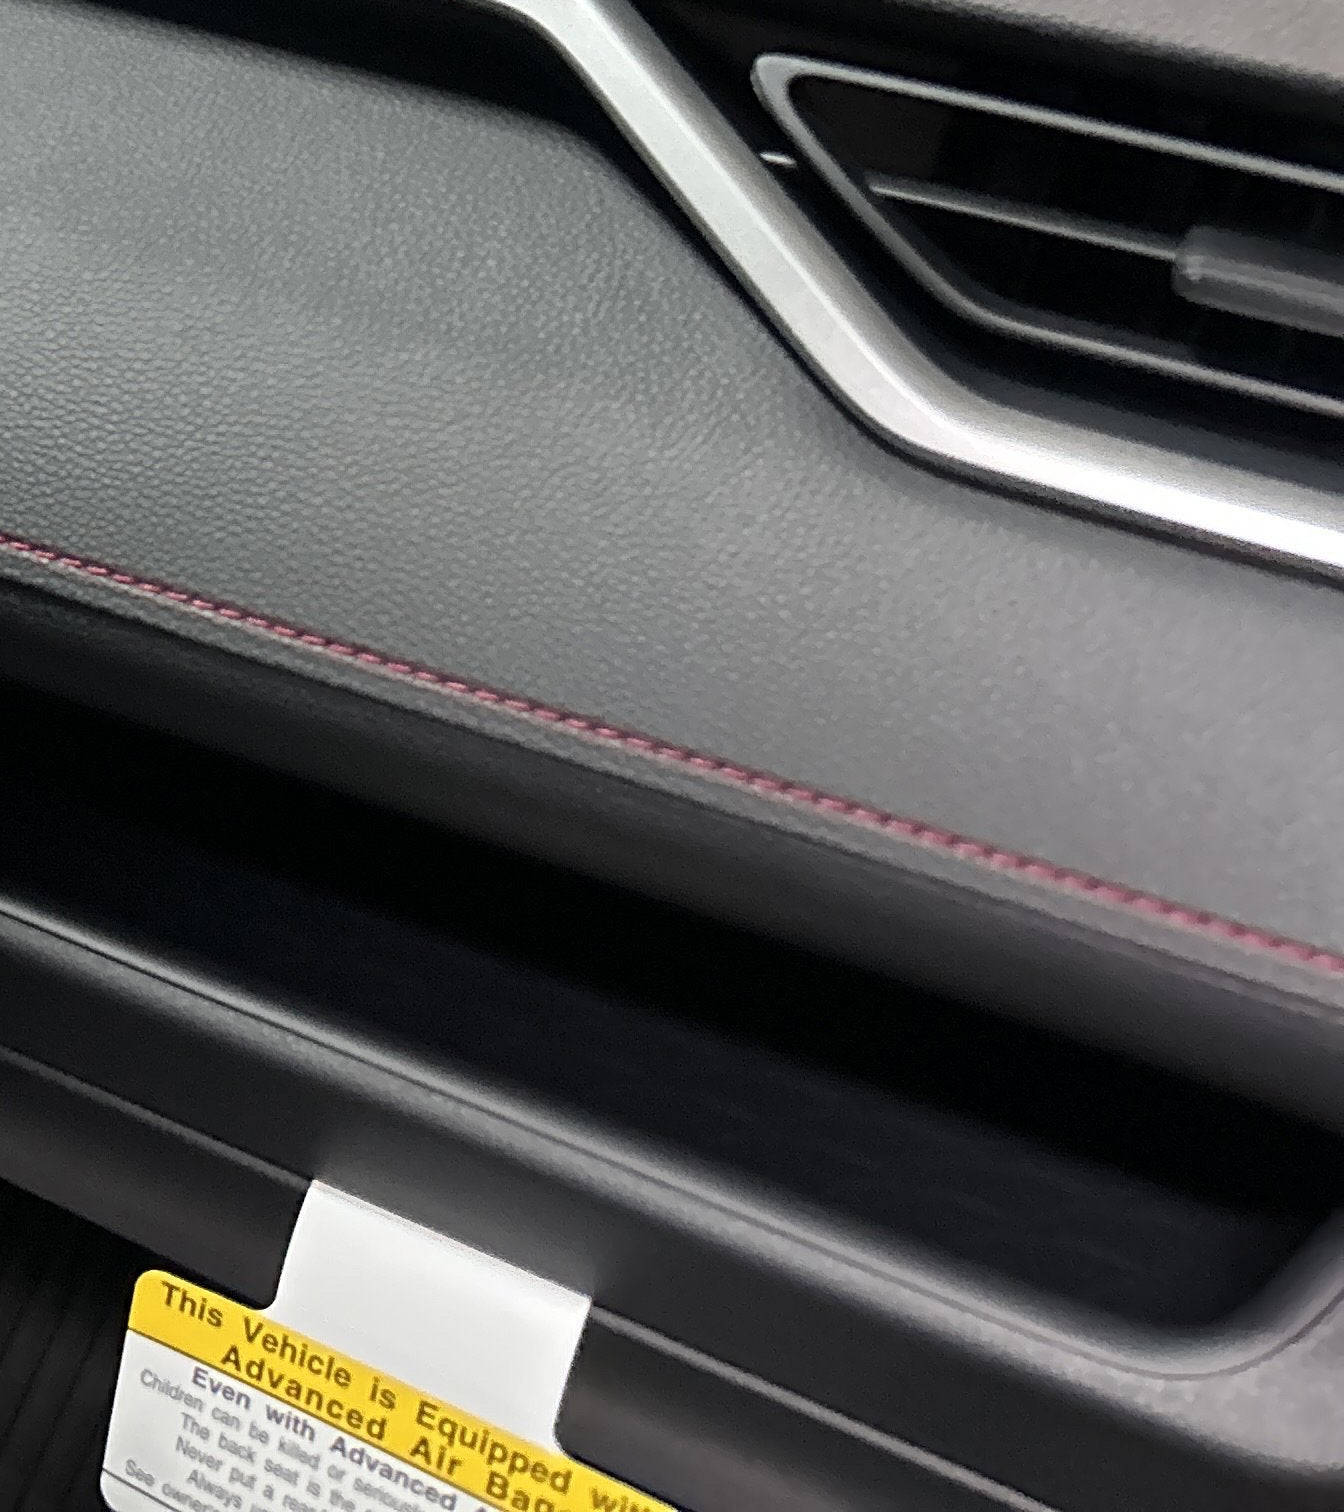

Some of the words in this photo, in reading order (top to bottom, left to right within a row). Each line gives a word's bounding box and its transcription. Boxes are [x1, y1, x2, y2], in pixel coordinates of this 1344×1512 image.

[139, 1368, 204, 1413] Children
[211, 1406, 241, 1432] can
[248, 1420, 270, 1445] be
[278, 1436, 321, 1471] killed
[327, 1464, 346, 1482] or
[161, 1279, 224, 1329] This
[243, 1314, 352, 1390] Vehicle
[369, 1375, 397, 1411] is
[415, 1399, 573, 1496] Equipped
[220, 1344, 388, 1442] Advanced
[409, 1435, 464, 1476] Air
[124, 1458, 155, 1487] See
[175, 1436, 224, 1472] Never
[228, 1468, 258, 1489] put
[262, 1484, 274, 1501] a
[181, 1411, 211, 1441] The
[218, 1432, 257, 1465] back
[263, 1458, 300, 1487] seat
[306, 1480, 322, 1498] is
[192, 1365, 251, 1410] Even
[265, 1403, 316, 1442] with
[329, 1435, 458, 1511] Advanced
[186, 1469, 243, 1510] Always
